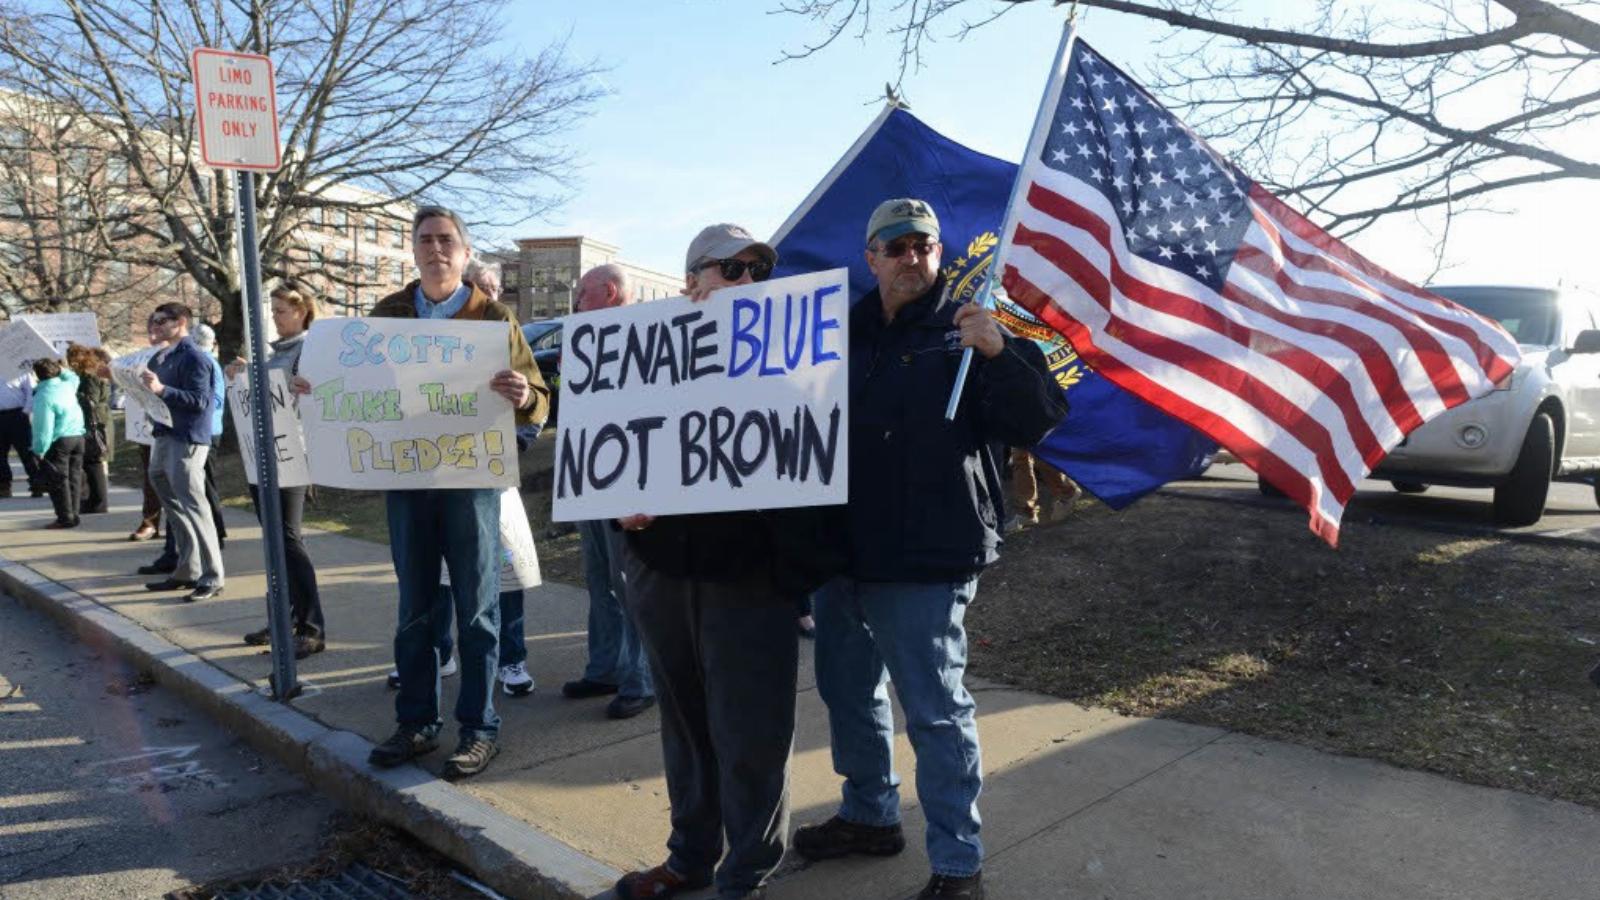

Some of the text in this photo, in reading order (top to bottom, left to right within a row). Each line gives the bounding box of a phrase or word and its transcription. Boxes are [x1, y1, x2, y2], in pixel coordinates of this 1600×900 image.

[219, 66, 252, 85] LIMO
[208, 92, 267, 112] PARKING
[222, 120, 256, 137] ONLY
[568, 284, 842, 394] SENATE BLUE
[313, 377, 403, 423] TAKE
[419, 382, 478, 417] THE
[346, 427, 505, 476] PLEDGE!
[557, 402, 840, 499] NOT BROWN
